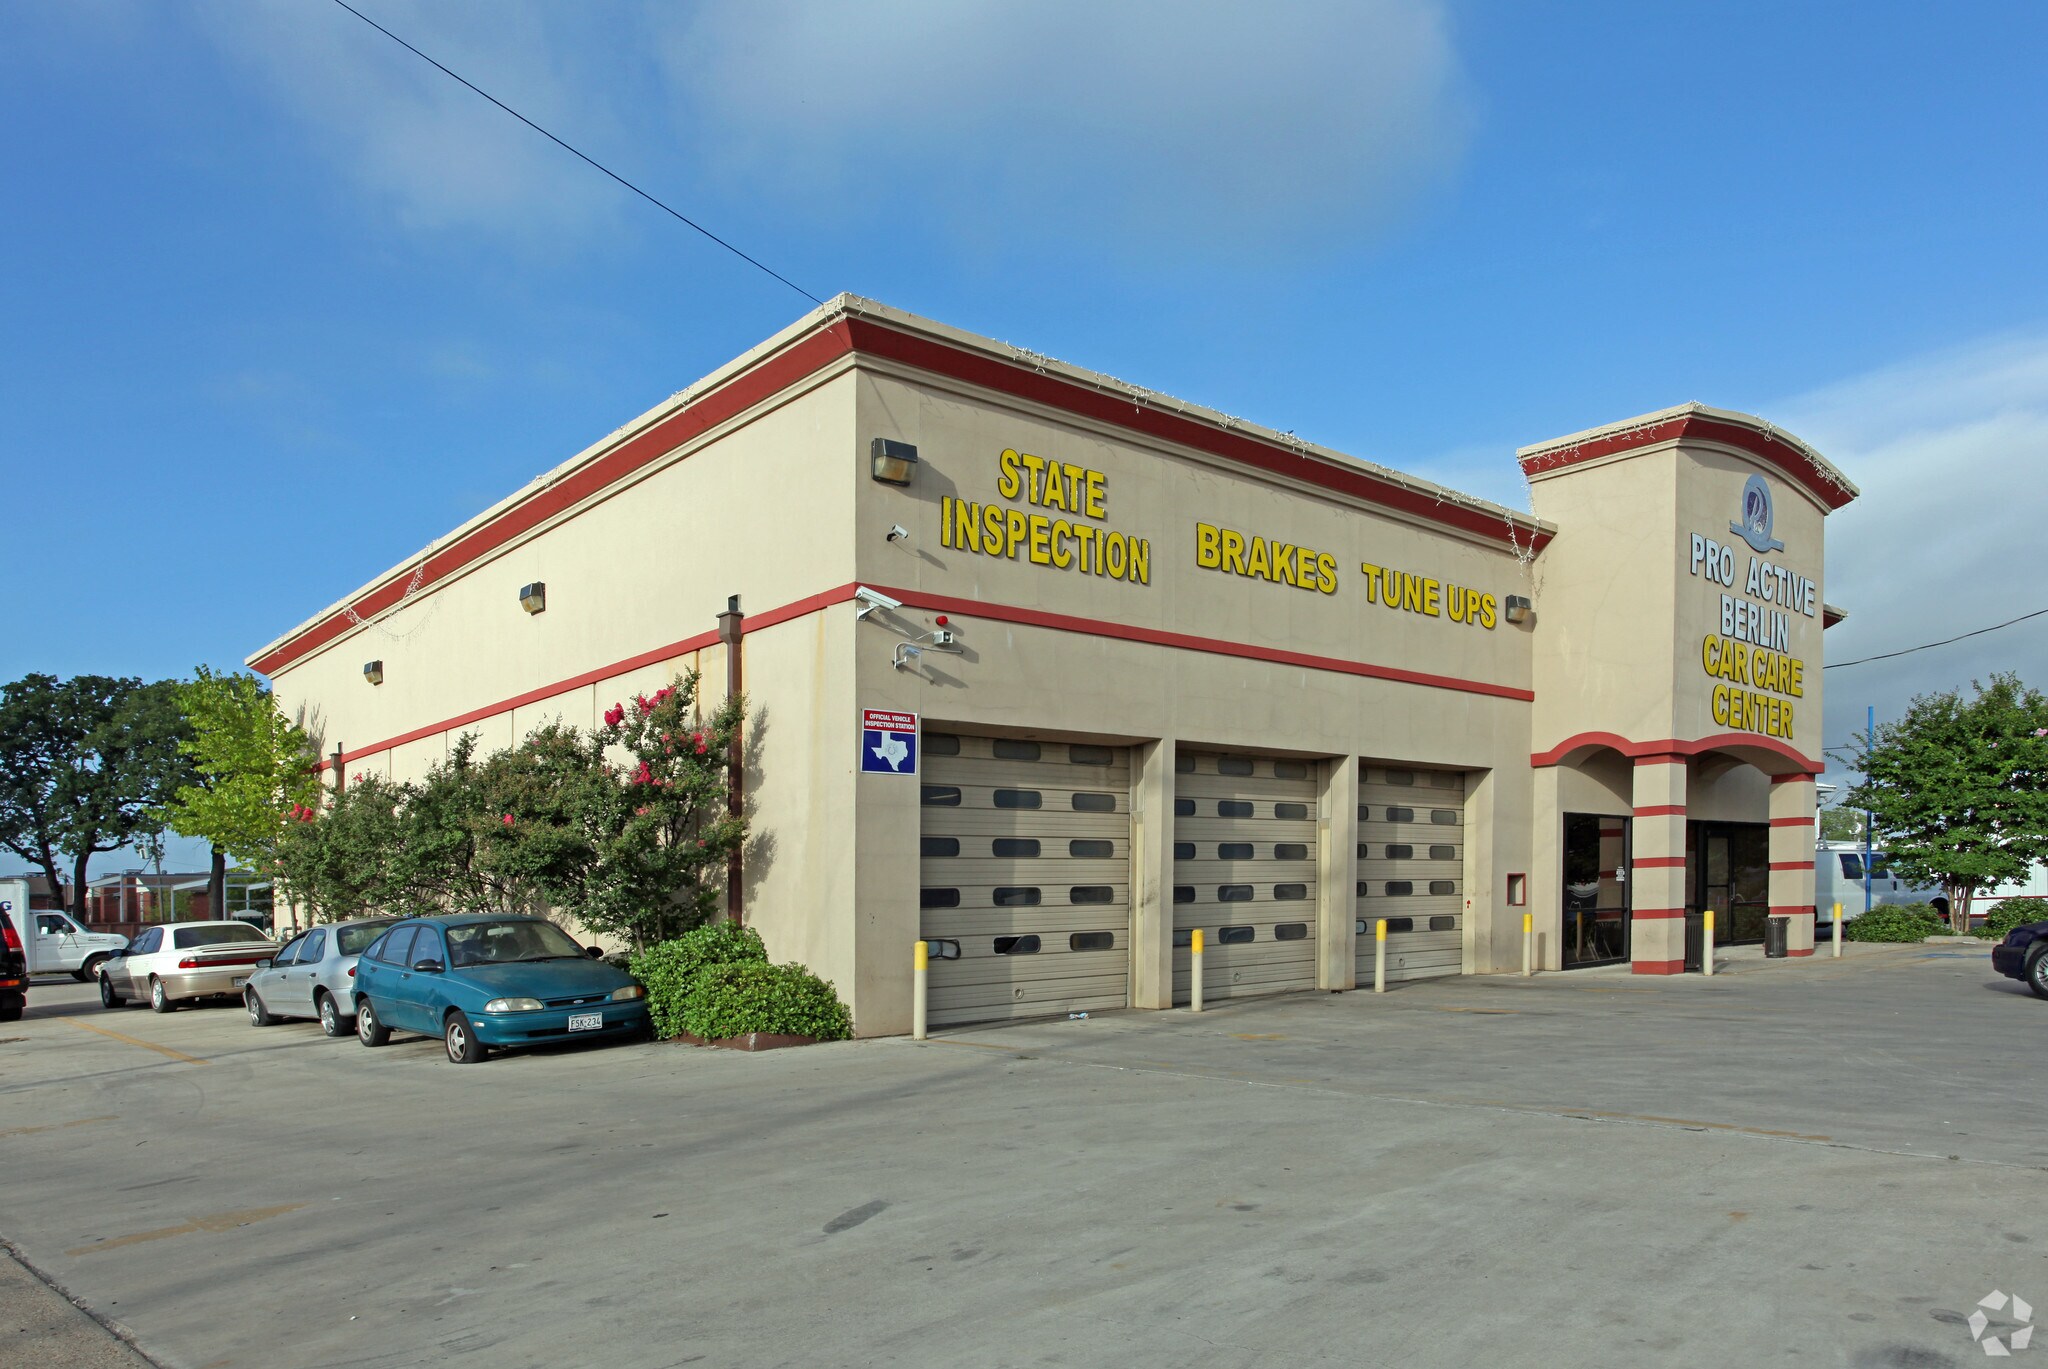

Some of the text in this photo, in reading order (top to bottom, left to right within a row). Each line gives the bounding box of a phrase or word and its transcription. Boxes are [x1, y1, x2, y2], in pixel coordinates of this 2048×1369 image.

[998, 448, 1105, 519] STATE
[941, 495, 1149, 584] INSPECTION
[1196, 522, 1337, 595] BRAKES
[1361, 562, 1497, 630] TUNE UPS
[1690, 532, 1816, 618] PRO ACTIVE
[1720, 593, 1790, 653] BERLIN
[1702, 633, 1804, 698] CAR CARE
[865, 720, 915, 730] INSPECTION STATION
[869, 713, 891, 721] OFFICIAL
[1712, 683, 1793, 740] CENTER
